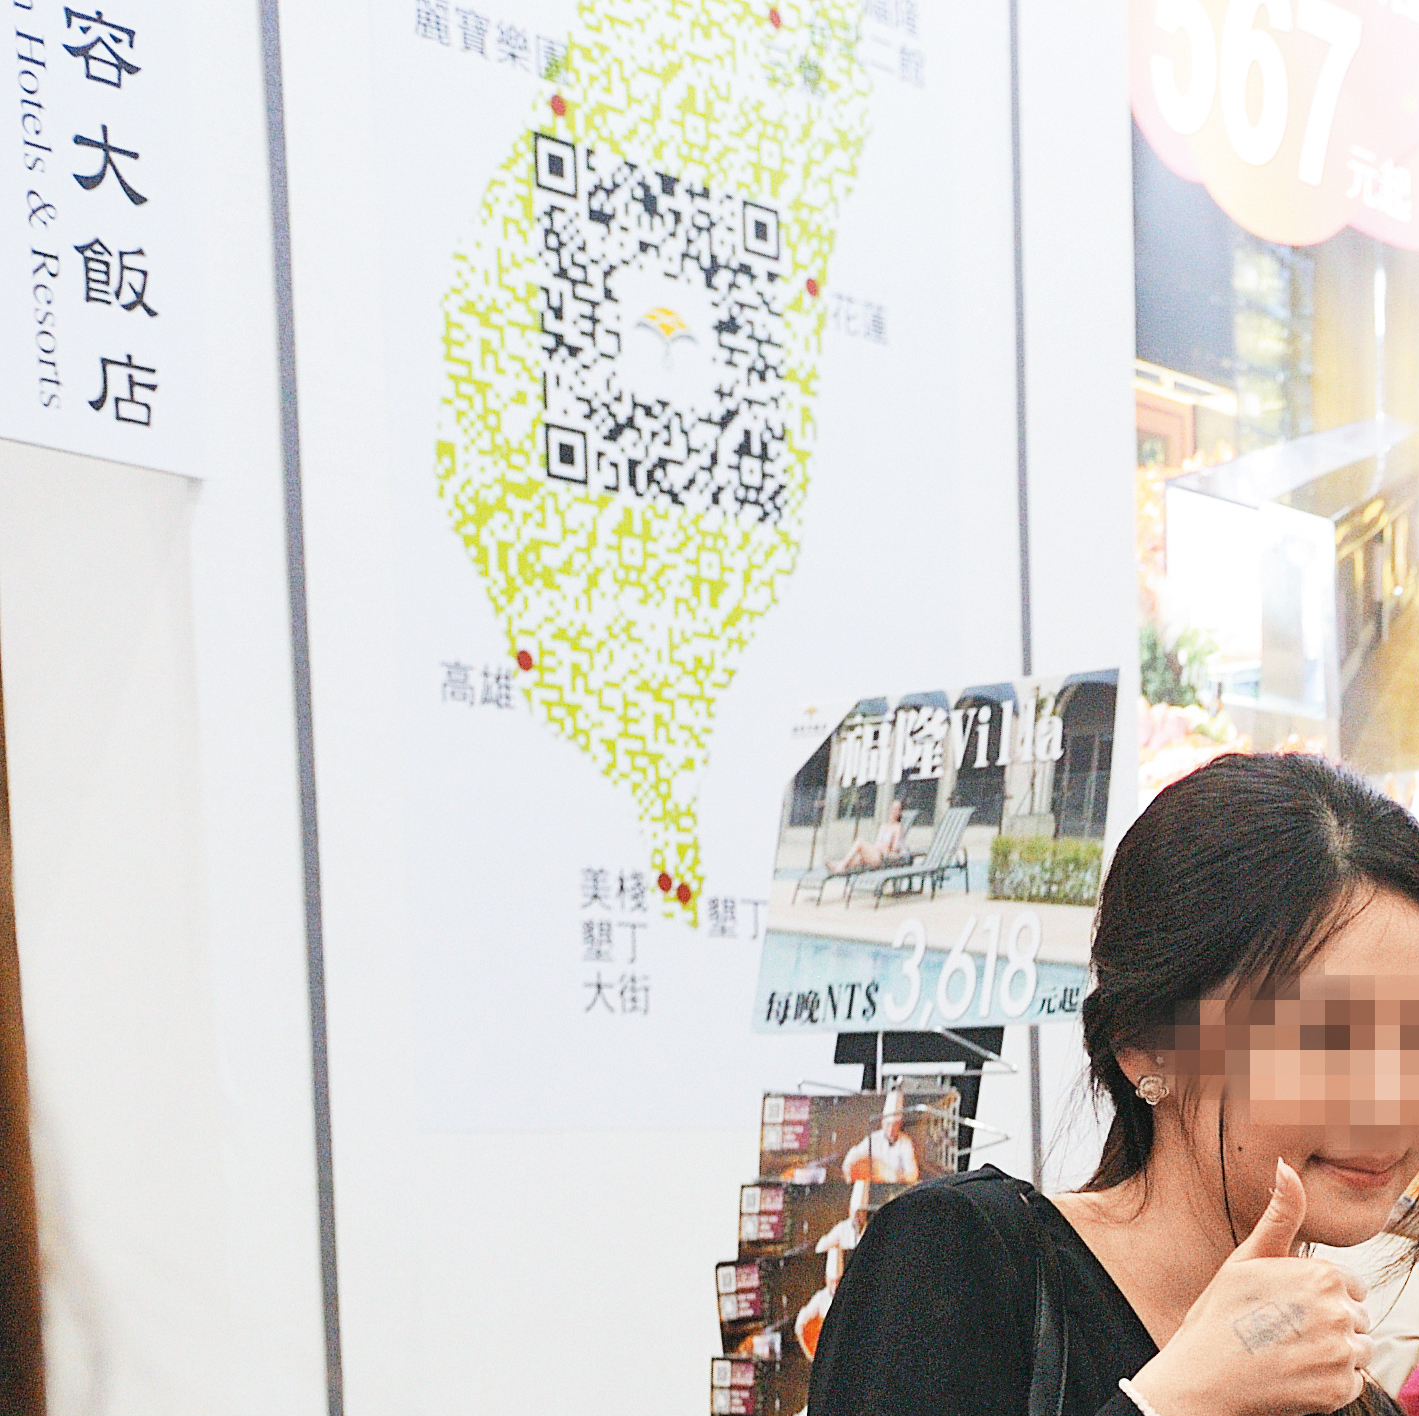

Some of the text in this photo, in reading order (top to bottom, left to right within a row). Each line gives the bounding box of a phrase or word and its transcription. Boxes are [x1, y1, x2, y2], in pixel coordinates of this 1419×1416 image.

[14, 28, 53, 174] Hotels
[1151, 0, 1362, 187] 567
[26, 188, 58, 229] &
[62, 6, 158, 427] 容大飯店
[30, 246, 63, 411] Resorts
[440, 659, 514, 709] 高雄
[836, 699, 1065, 788] 福隆Villa
[583, 919, 648, 964] 墾丁
[707, 897, 768, 939] 墾丁
[584, 972, 650, 1015] 大街
[766, 980, 879, 1025] 每晚NT$
[883, 910, 1042, 1029] 3,618
